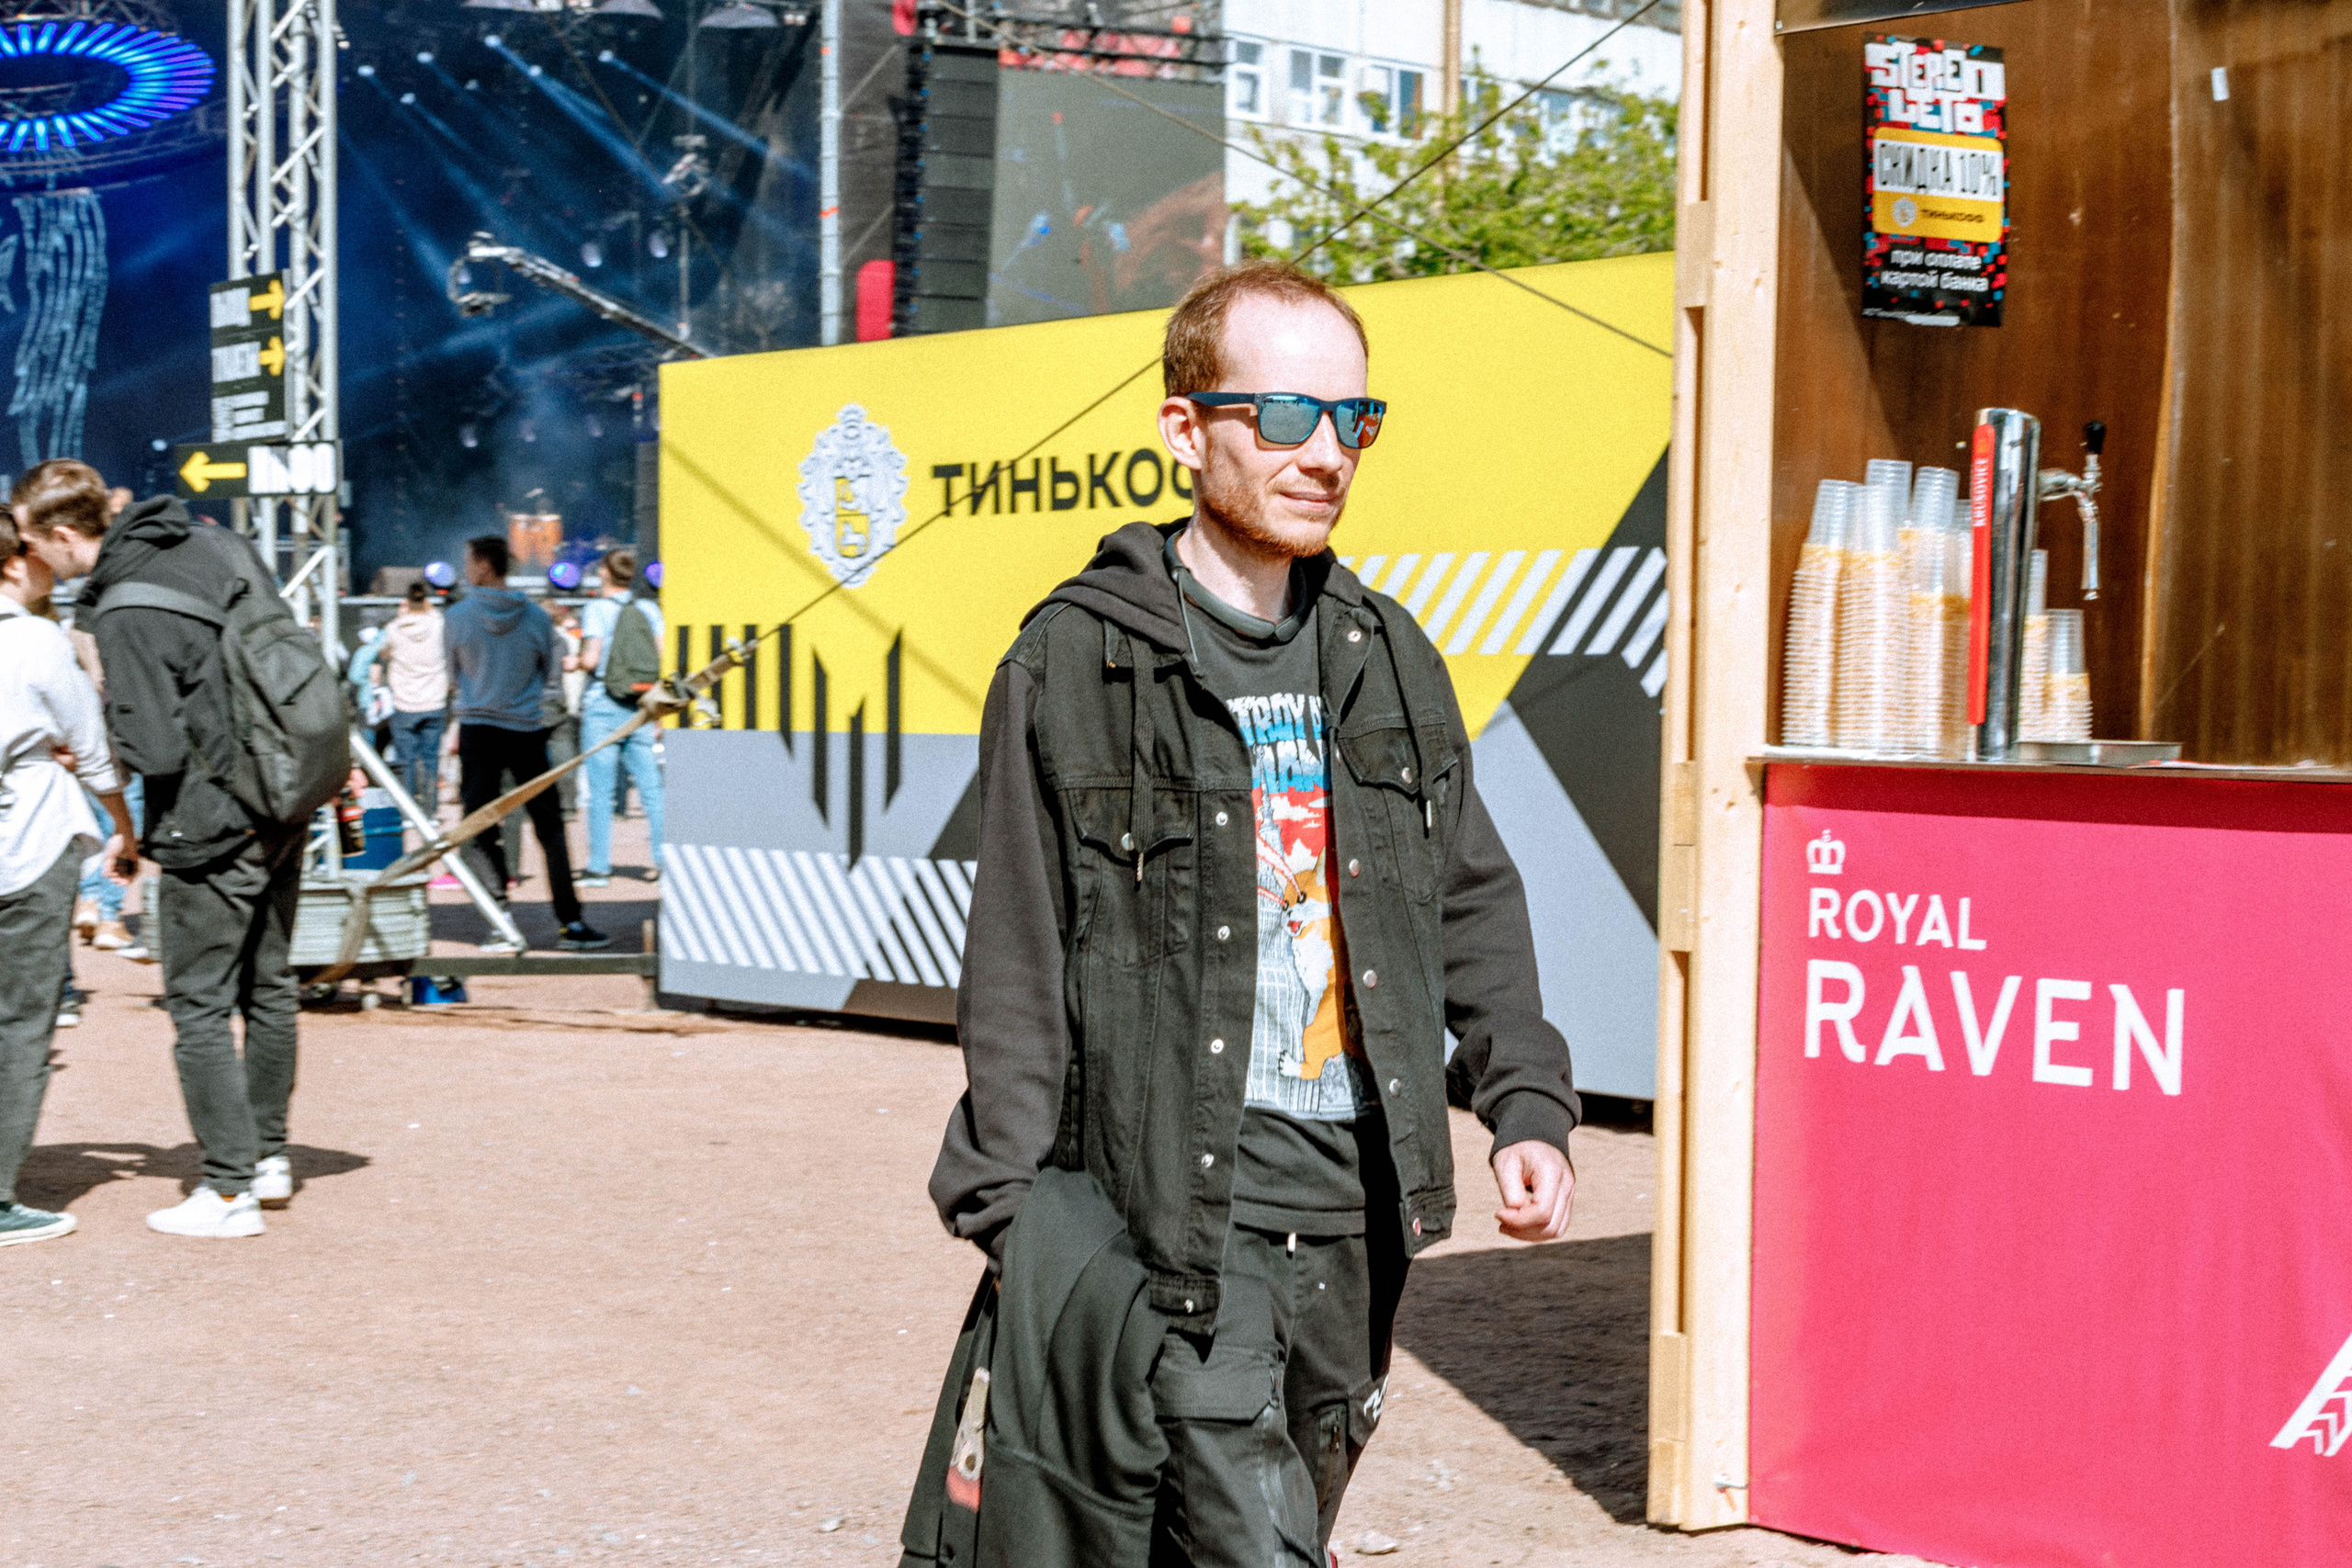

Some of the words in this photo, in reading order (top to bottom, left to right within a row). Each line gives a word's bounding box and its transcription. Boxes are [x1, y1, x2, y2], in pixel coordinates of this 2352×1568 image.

[1887, 88, 1984, 133] LETO
[1881, 269, 1939, 289] картой
[1939, 271, 1989, 292] банка
[1890, 250, 1924, 267] при
[1924, 253, 1982, 270] оплате
[932, 447, 1193, 518] ТИНЬКО
[1226, 692, 1306, 747] TROY
[1808, 887, 1987, 951] ROYAL
[1804, 959, 2185, 1096] RAVEN
